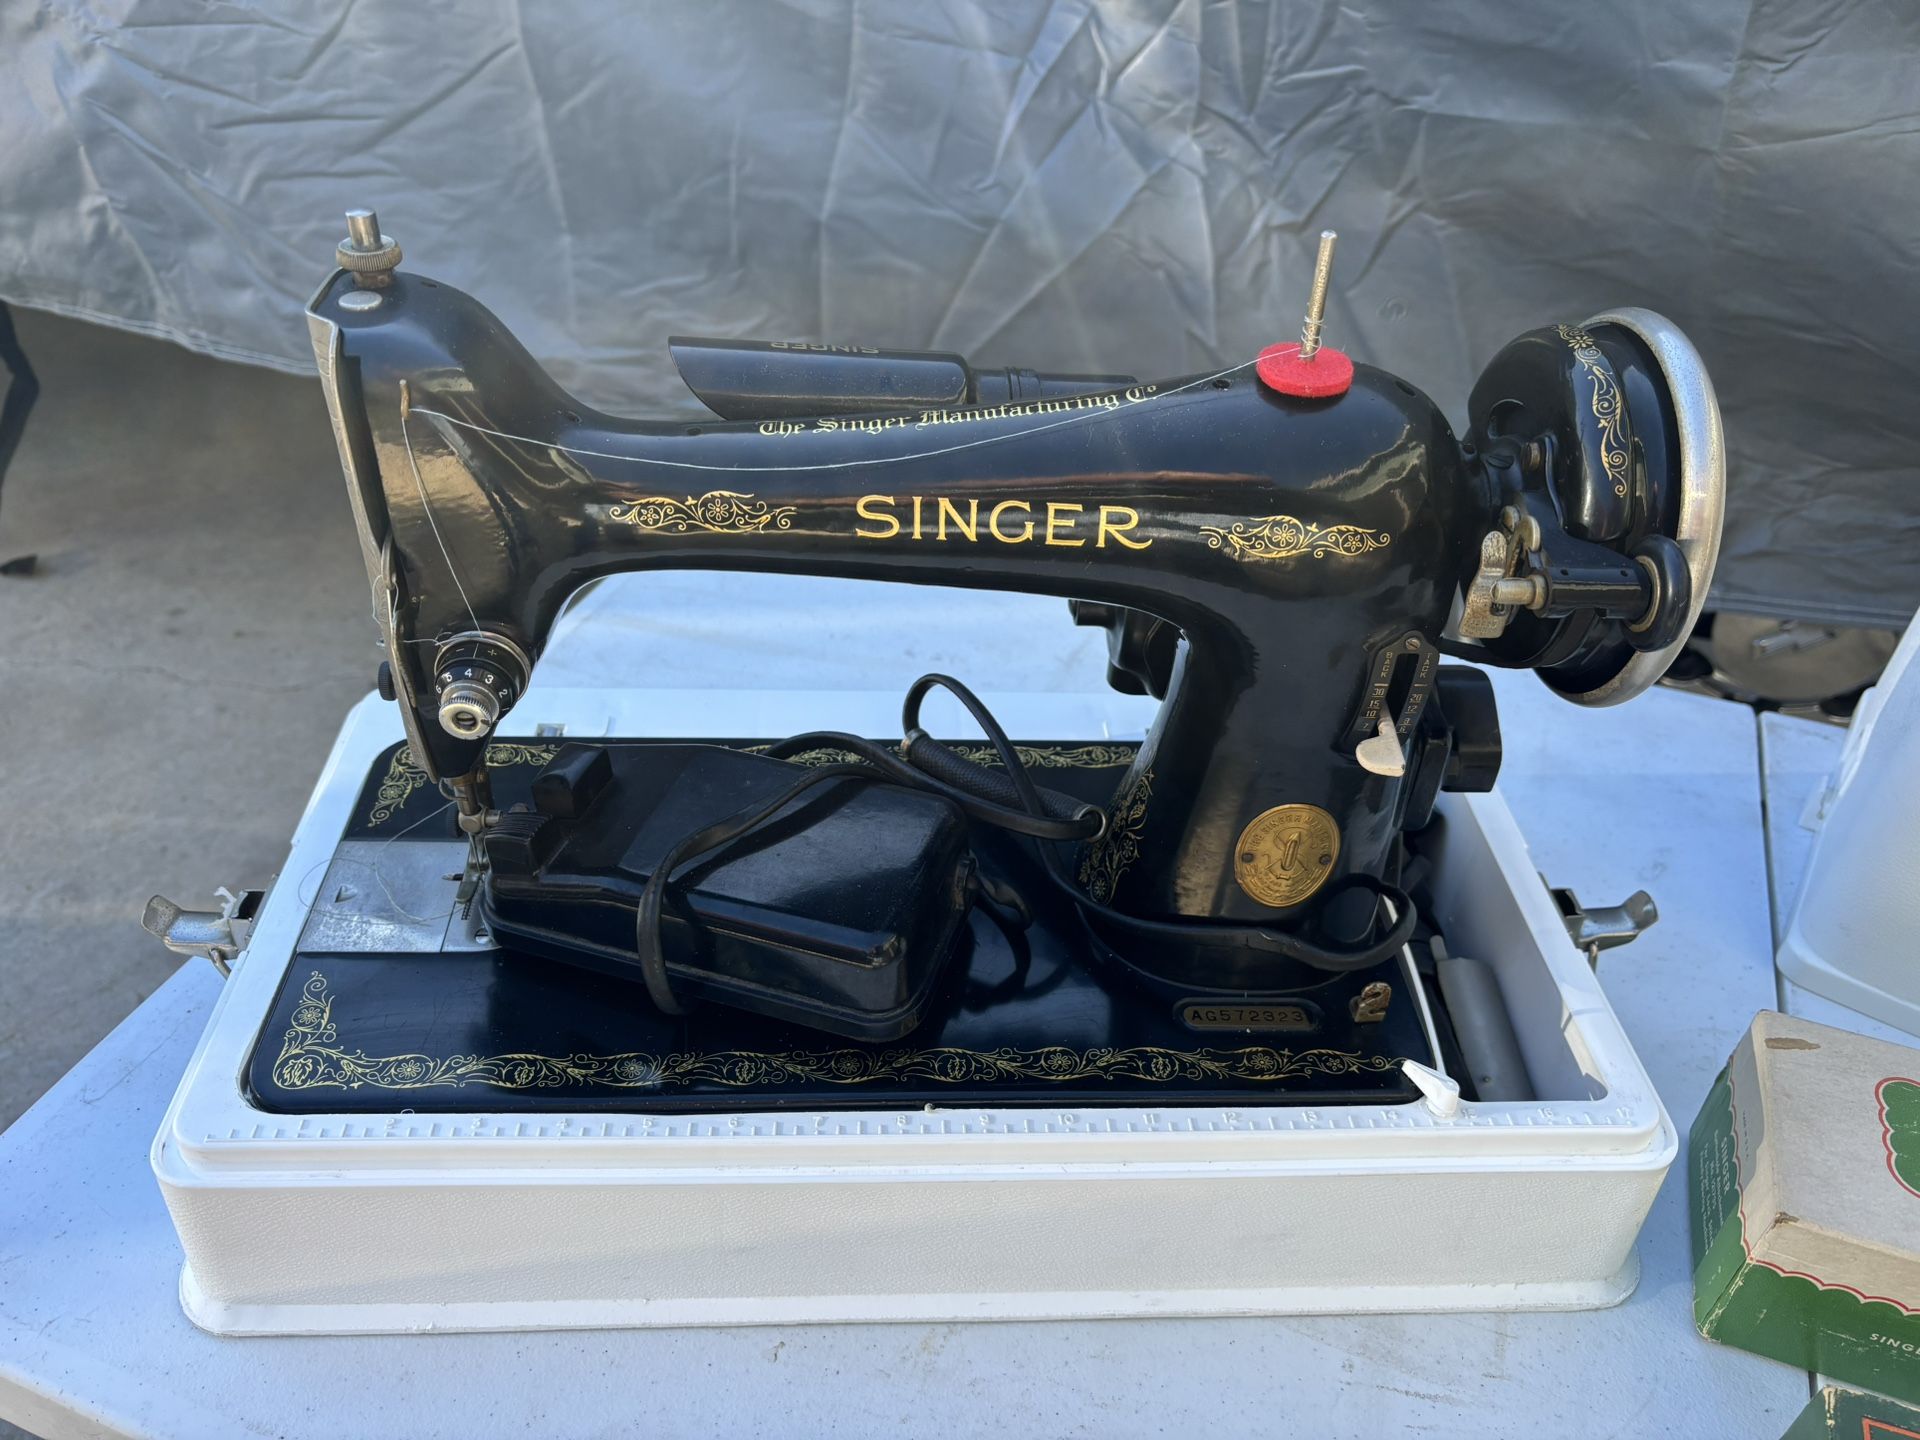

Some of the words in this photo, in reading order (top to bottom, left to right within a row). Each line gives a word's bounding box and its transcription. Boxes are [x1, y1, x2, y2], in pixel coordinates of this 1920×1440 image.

[759, 420, 805, 439] The
[812, 415, 911, 435] Singer
[916, 392, 1119, 431] Manufacturing
[855, 494, 1153, 550] SINGER
[1379, 652, 1393, 678] BACK
[1419, 652, 1433, 679] TACK
[464, 668, 473, 678] 4
[484, 674, 495, 685] 3
[498, 688, 508, 699] 2
[1372, 688, 1385, 697] 30
[1365, 710, 1377, 718] 10
[1368, 699, 1381, 708] 15
[1191, 1009, 1304, 1023] AG572323
[556, 1117, 569, 1129] 4
[642, 1117, 654, 1129] 5
[728, 1117, 739, 1129] 6
[812, 1115, 824, 1127] 7
[896, 1114, 908, 1126] 8
[978, 1114, 990, 1126] 9
[1057, 1114, 1075, 1125] 10
[1142, 1113, 1156, 1125] 11
[1221, 1111, 1238, 1124] 12
[1301, 1110, 1318, 1123] 13
[1381, 1110, 1398, 1121] 14
[1536, 1108, 1553, 1120] 16
[1616, 1107, 1631, 1119] 17
[1720, 1136, 1731, 1196] SINGER
